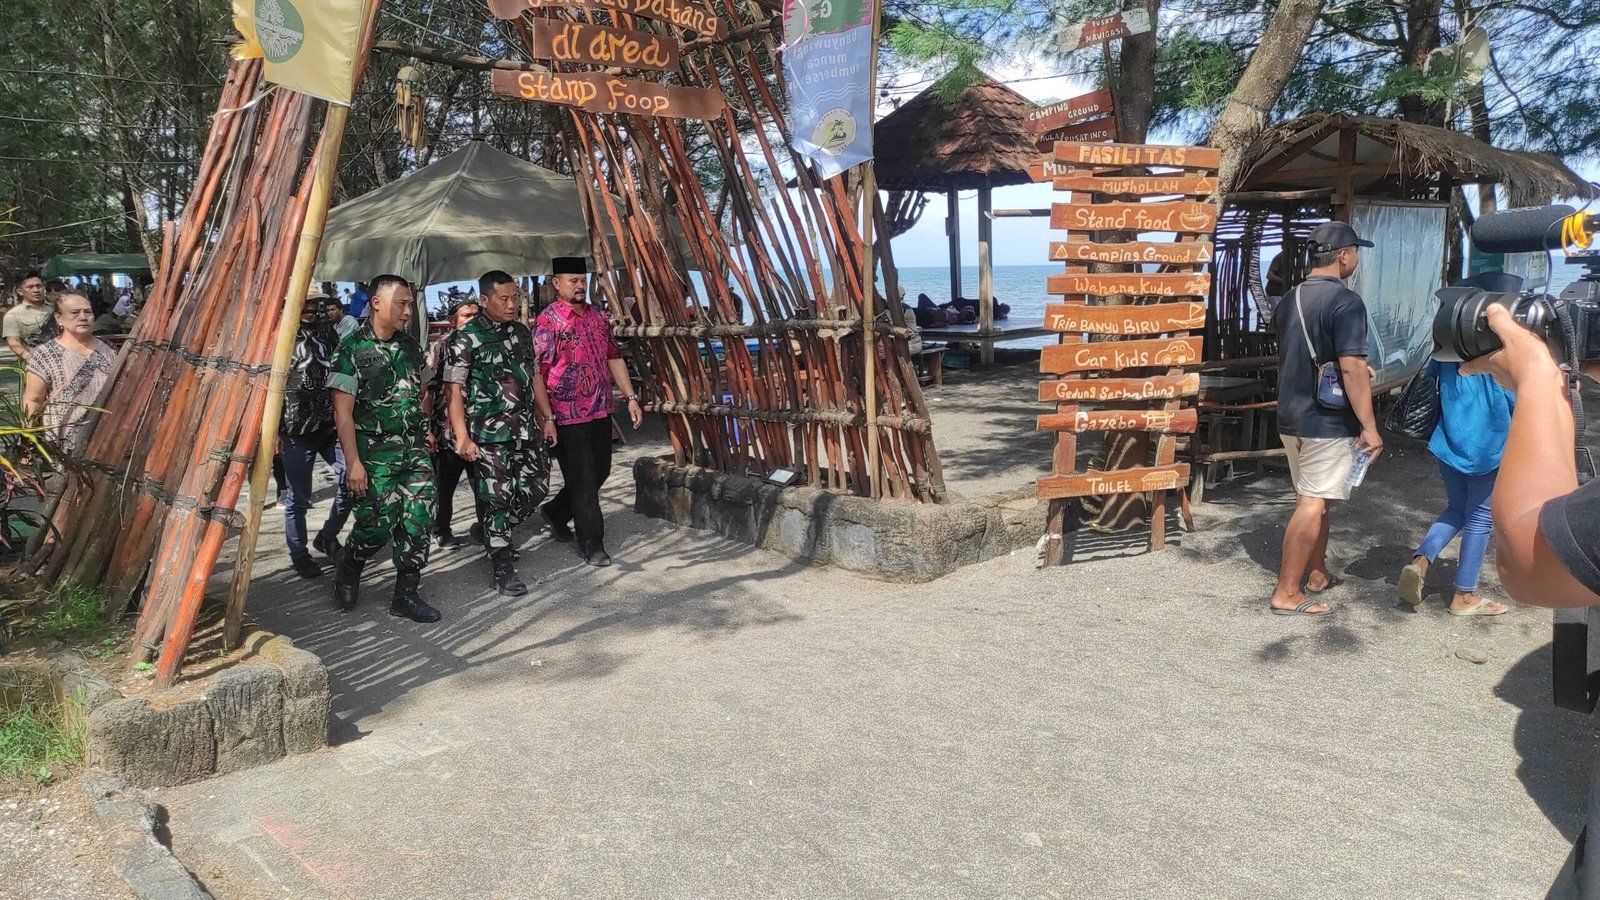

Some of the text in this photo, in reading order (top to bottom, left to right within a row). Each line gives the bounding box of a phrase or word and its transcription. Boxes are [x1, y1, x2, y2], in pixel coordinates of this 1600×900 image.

[1085, 28, 1124, 43] NAVIGASI
[1068, 104, 1099, 119] GROUND
[1079, 145, 1186, 166] FASILITAS
[1076, 208, 1131, 232] Stand
[1077, 245, 1139, 262] Camping
[1074, 278, 1175, 295] Wahana Kuda
[1080, 319, 1119, 334] BANYU
[1124, 319, 1160, 334] BIRU
[1075, 349, 1149, 367] Car Kids
[1056, 382, 1096, 399] Gedung
[1142, 381, 1175, 397] Guna
[1074, 411, 1137, 433] Gazebo
